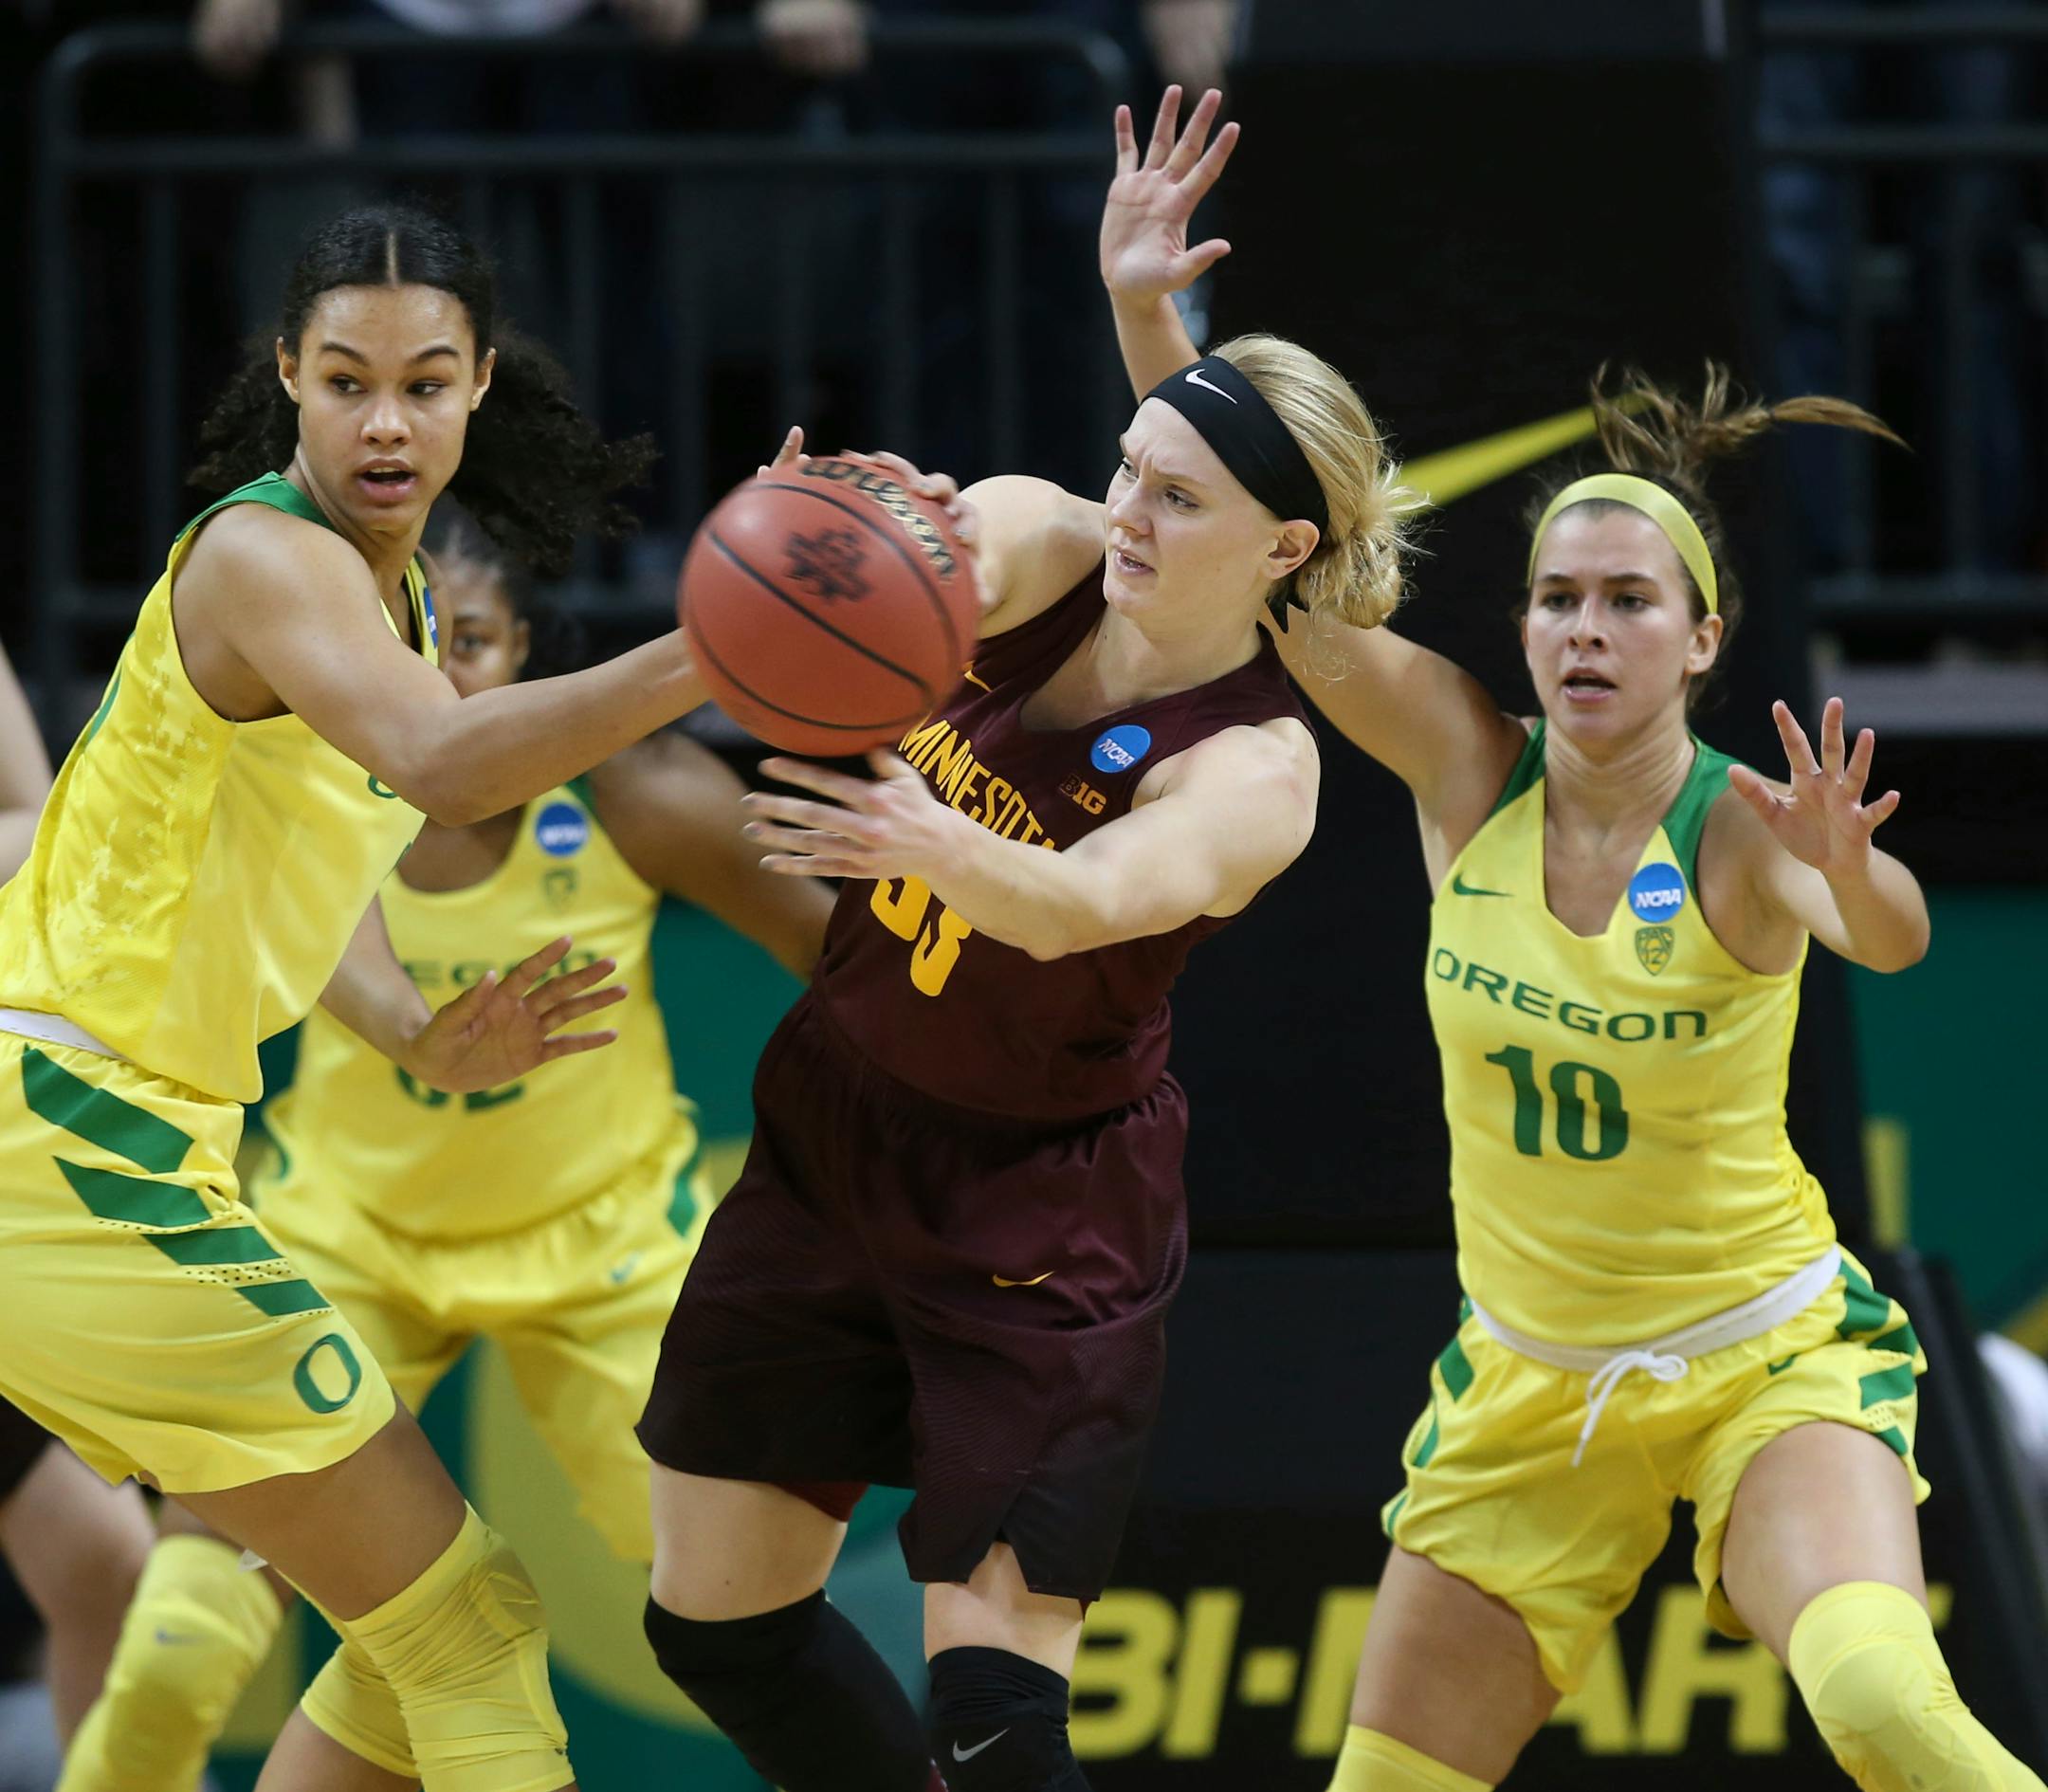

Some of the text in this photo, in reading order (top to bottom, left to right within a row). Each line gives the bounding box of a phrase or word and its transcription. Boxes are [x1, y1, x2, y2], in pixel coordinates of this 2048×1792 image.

[898, 710, 1055, 849] MINNESOT
[1098, 738, 1135, 768] NCAA
[1635, 887, 1682, 908] NCAA
[1433, 947, 1708, 1042] OREGON
[1485, 1044, 1630, 1162] 10
